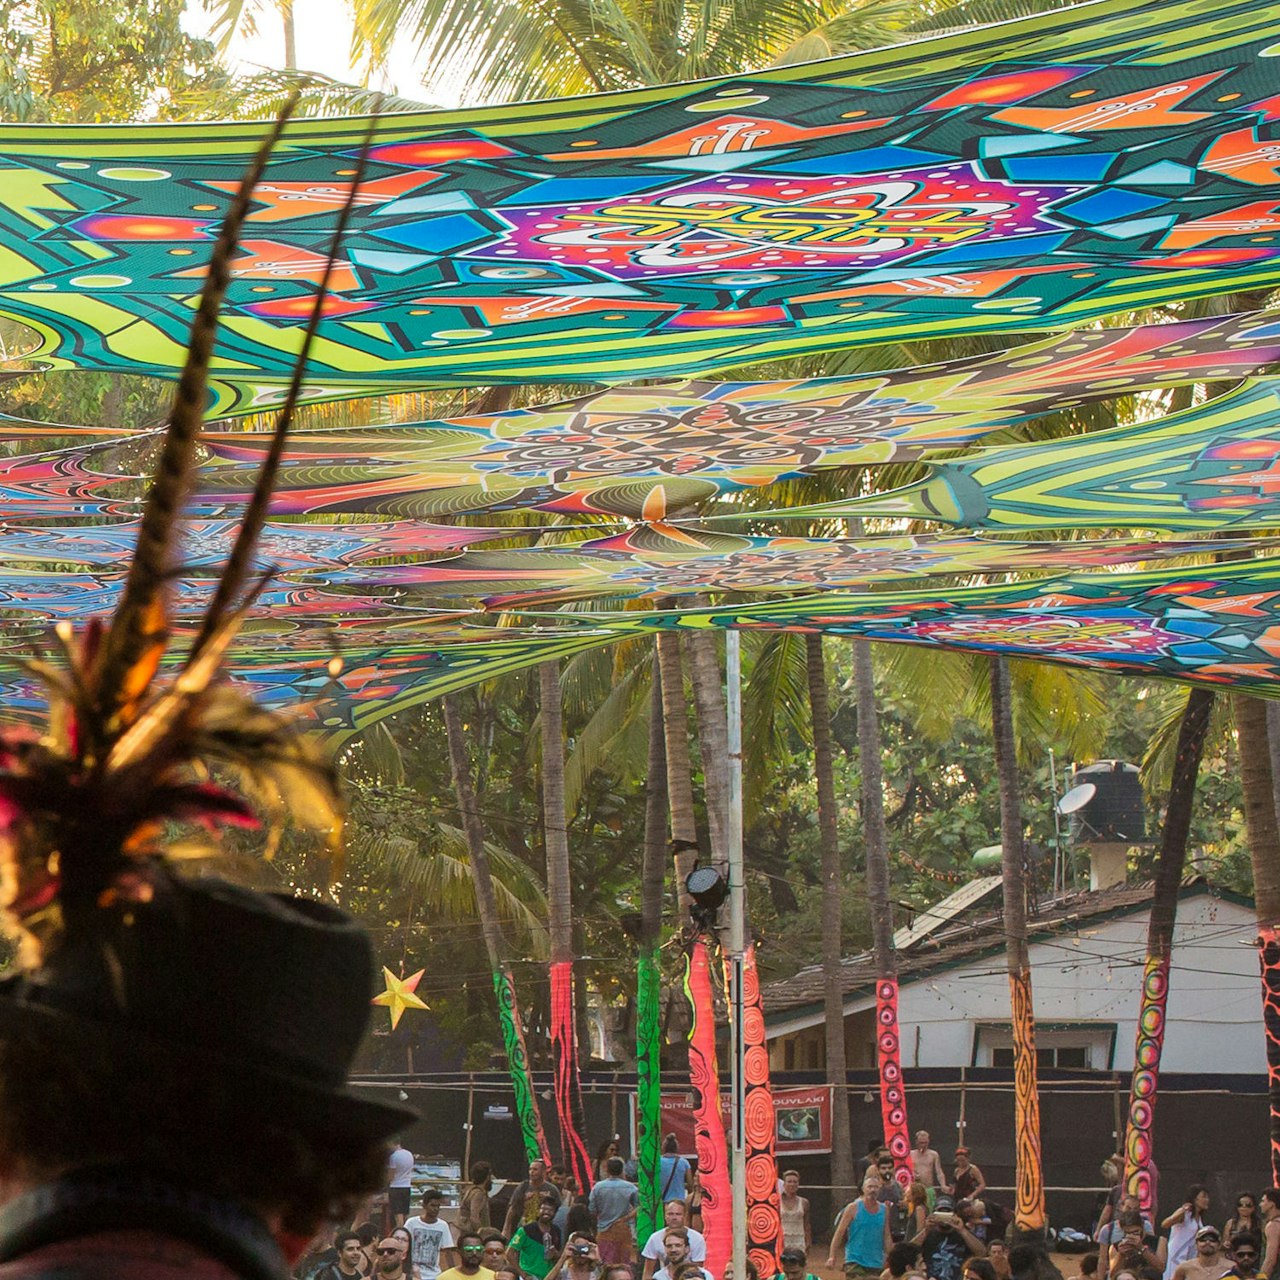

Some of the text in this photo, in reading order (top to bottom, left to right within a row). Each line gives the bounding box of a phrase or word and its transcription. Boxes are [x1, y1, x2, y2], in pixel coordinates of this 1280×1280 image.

[598, 204, 988, 227] TOP
[559, 214, 986, 243] HILL
[772, 1096, 825, 1105] OUVLAKI
